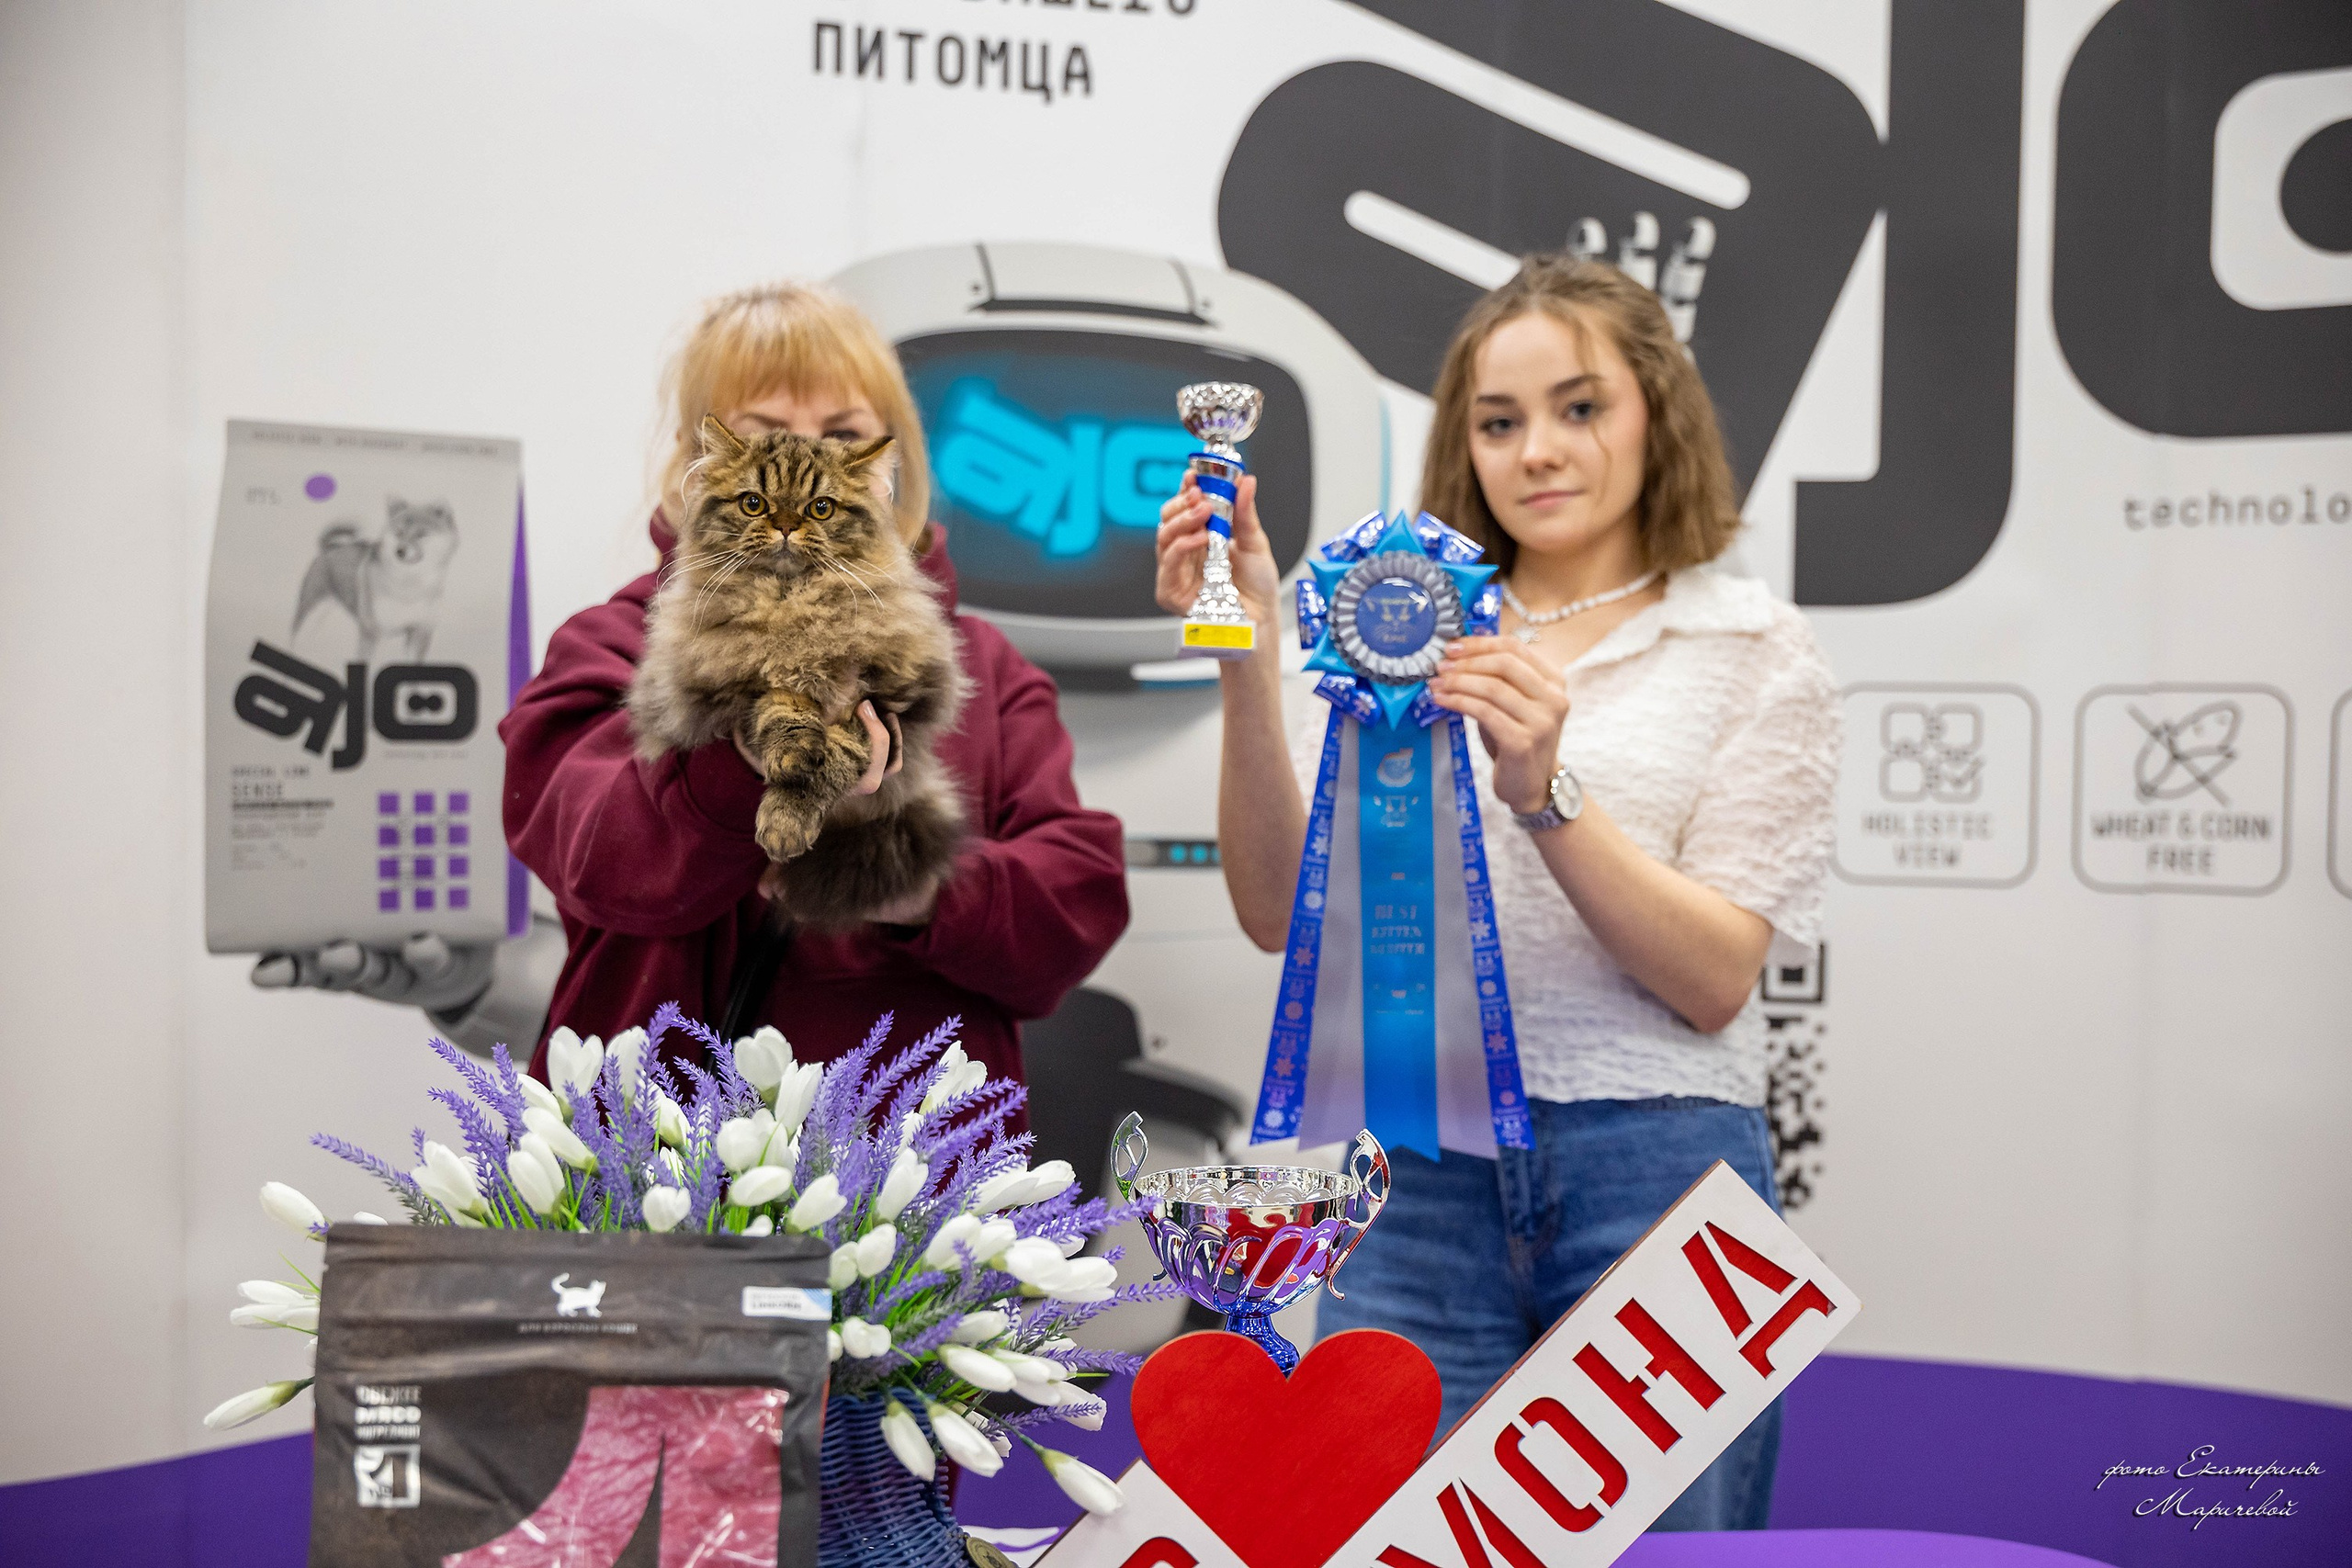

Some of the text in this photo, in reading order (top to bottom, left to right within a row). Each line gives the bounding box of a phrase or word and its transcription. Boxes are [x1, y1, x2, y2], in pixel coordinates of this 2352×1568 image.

[812, 21, 1094, 104] ПИТОМЦА
[2123, 484, 2352, 530] technolo
[1861, 812, 1992, 840] HOLISTIC
[2091, 812, 2171, 840] WHEAT
[1894, 841, 1962, 867] VIEW
[2146, 844, 2213, 874] FREE
